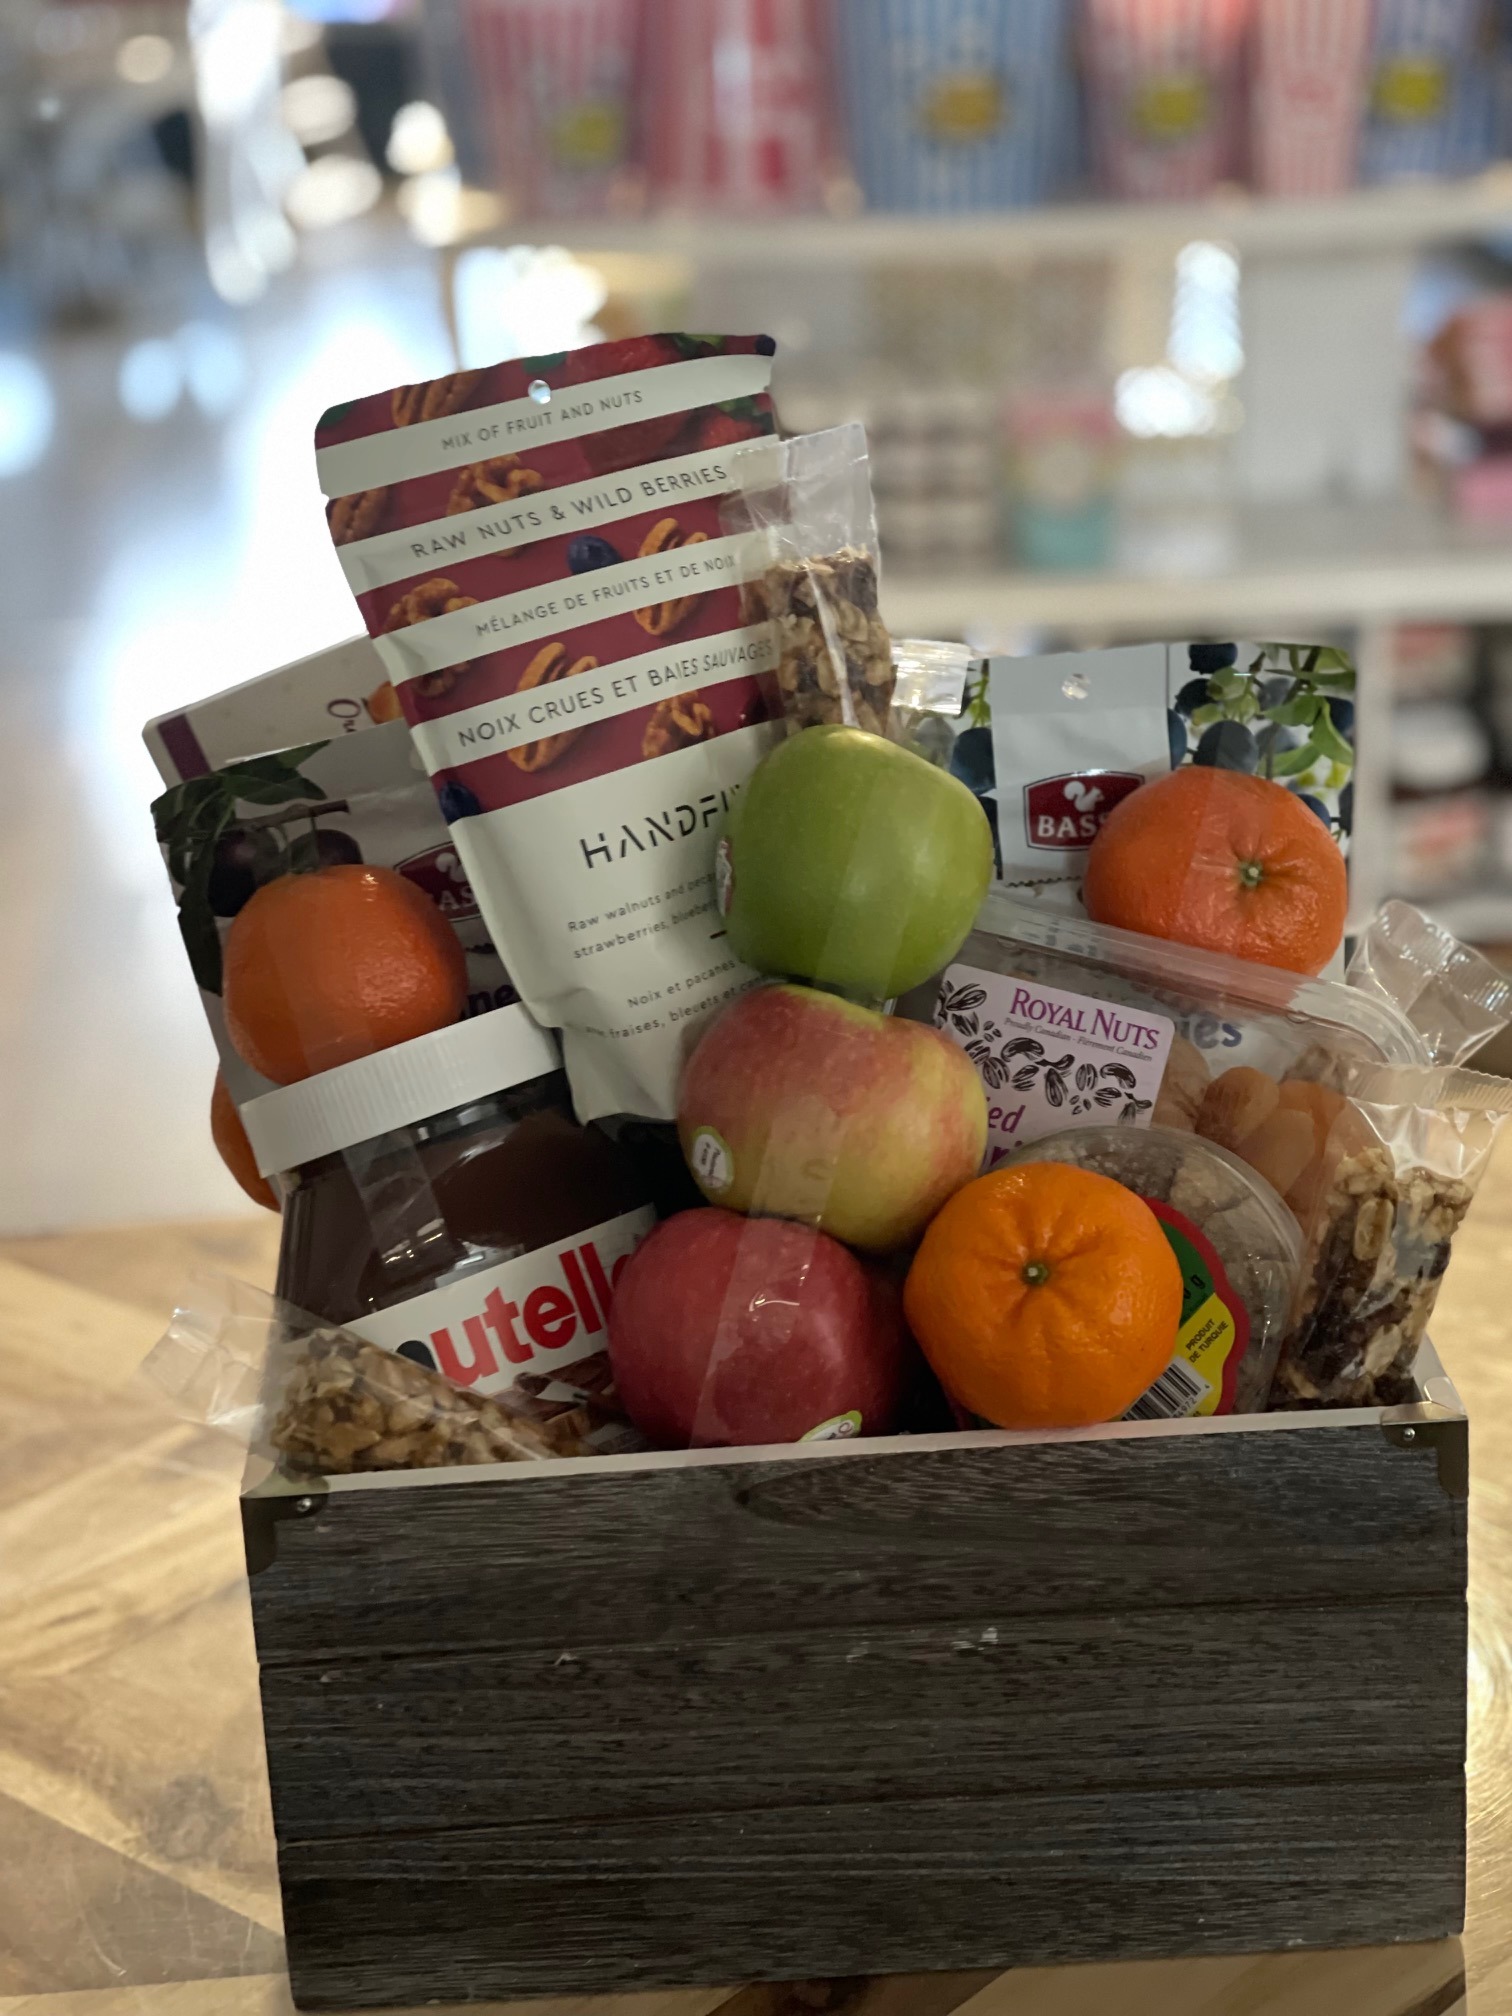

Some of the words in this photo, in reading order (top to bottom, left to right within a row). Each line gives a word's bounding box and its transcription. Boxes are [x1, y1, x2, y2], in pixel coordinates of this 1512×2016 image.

[441, 433, 473, 450] MIX
[478, 424, 499, 442] OF
[506, 411, 553, 435] FRUIT
[560, 402, 594, 421] AND
[599, 390, 643, 411] NUTS
[410, 531, 467, 559] RAW
[477, 511, 542, 540] NUTS
[549, 504, 567, 521] &
[569, 486, 633, 515] WILD
[639, 464, 728, 497] BERRIES
[475, 600, 559, 637] MÉLANGE
[564, 592, 588, 611] DE
[591, 575, 651, 602] FRUITS
[654, 568, 676, 585] ET
[679, 562, 701, 578] DE
[703, 554, 737, 573] NOIX
[456, 713, 522, 747] NOIX
[527, 687, 605, 724] CRUES
[611, 674, 641, 698] ET
[647, 657, 700, 688] BAIES
[567, 915, 600, 933] Raw
[604, 894, 662, 920] walnuts
[627, 990, 663, 1008] Noix
[666, 981, 682, 995] et
[685, 958, 737, 989] pacanes
[1009, 987, 1087, 1034] ROYAL
[1090, 1008, 1160, 1050] NUTS
[1185, 1318, 1216, 1351] PRODUIT
[1189, 1351, 1201, 1363] DE
[1198, 1321, 1229, 1352] TURQUIE
